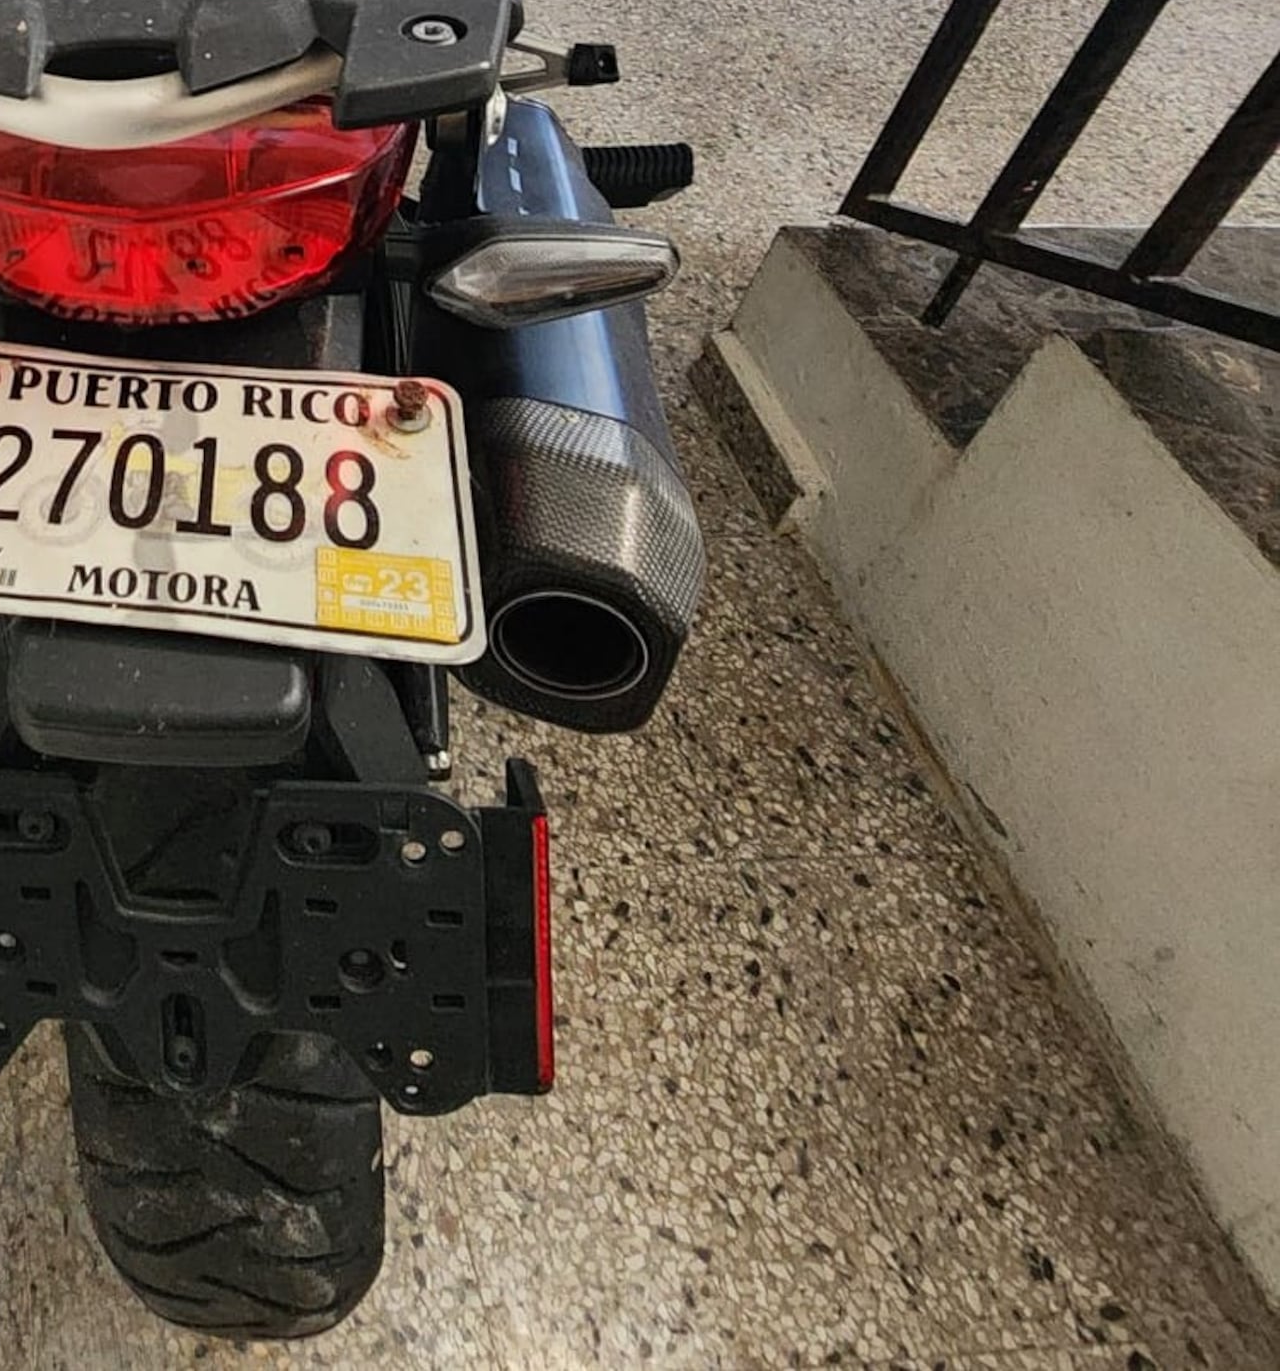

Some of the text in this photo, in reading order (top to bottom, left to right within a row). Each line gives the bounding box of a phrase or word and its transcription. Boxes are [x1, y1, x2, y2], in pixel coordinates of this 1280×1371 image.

[8, 366, 370, 428] PUERTO RICO
[68, 564, 262, 612] MOTORA
[377, 568, 431, 602] 23
